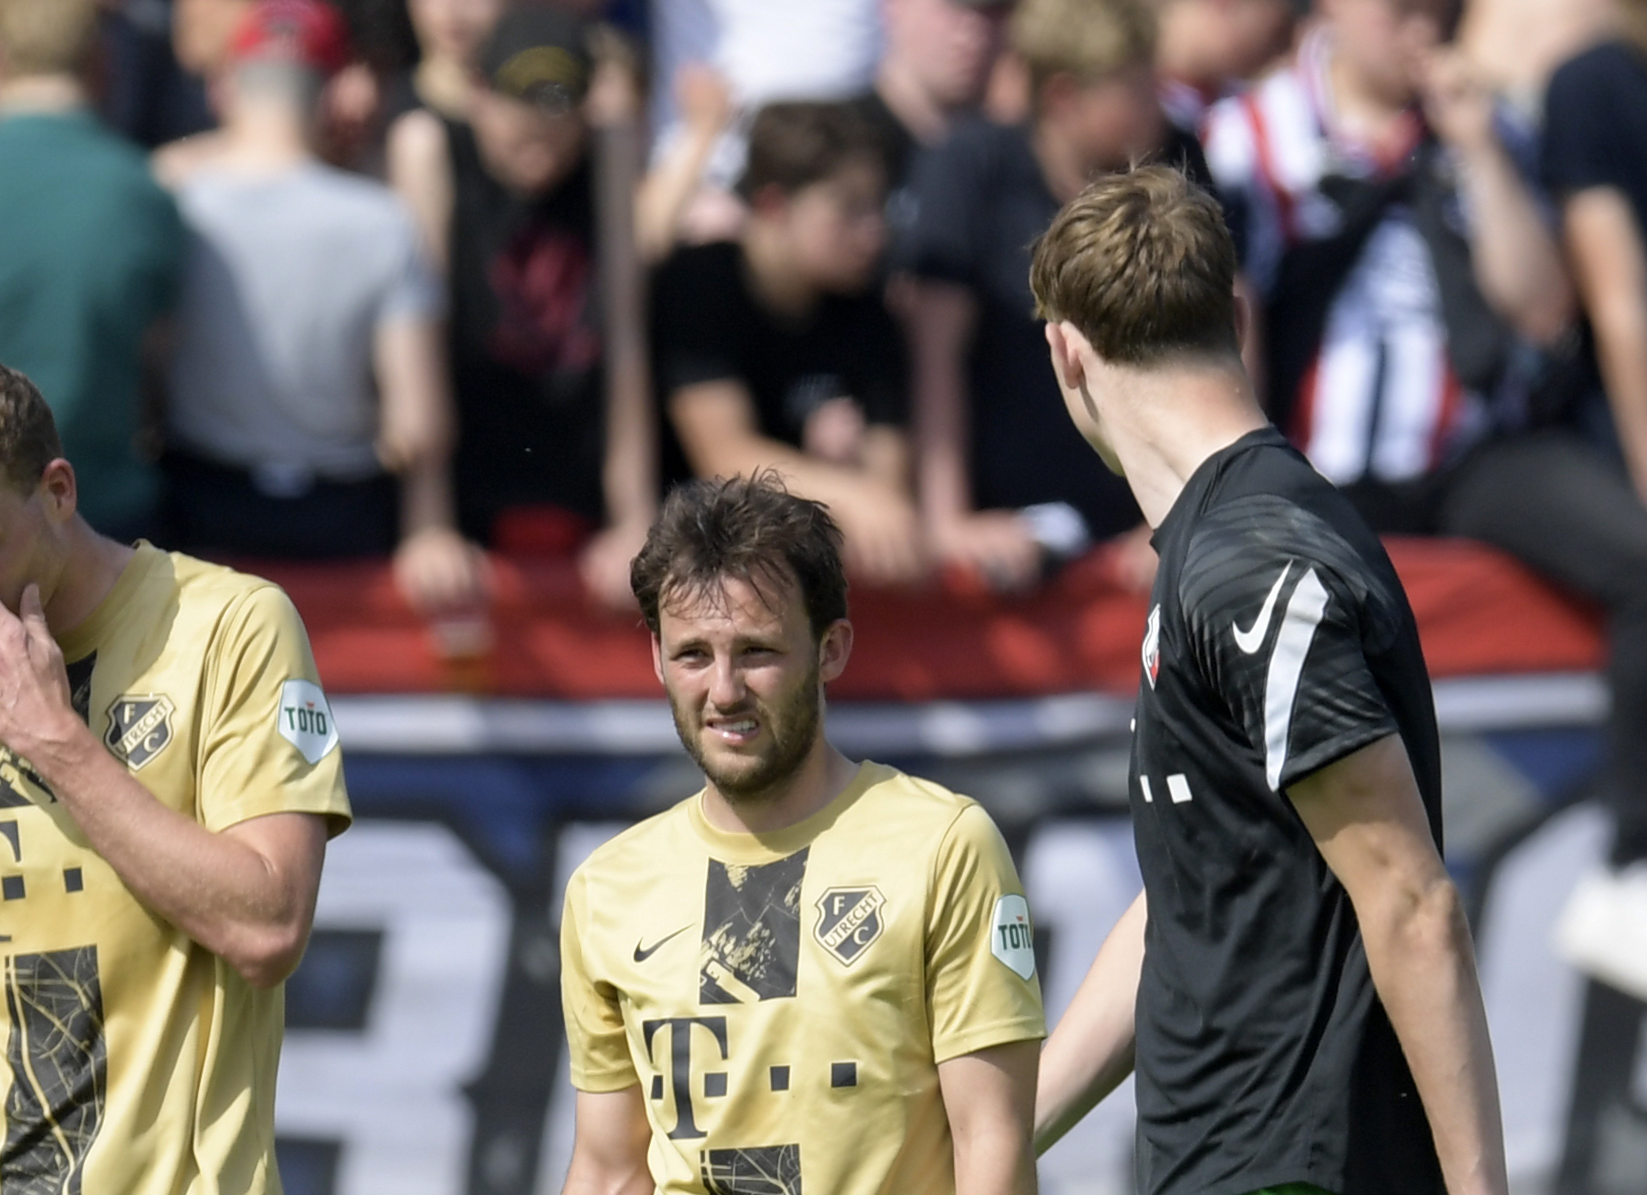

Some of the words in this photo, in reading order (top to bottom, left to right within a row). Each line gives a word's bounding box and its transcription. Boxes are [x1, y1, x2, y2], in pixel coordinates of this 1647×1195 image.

[284, 707, 327, 735] TOTO
[834, 895, 845, 915] F
[824, 893, 877, 947] UTRECHT
[854, 926, 869, 945] C
